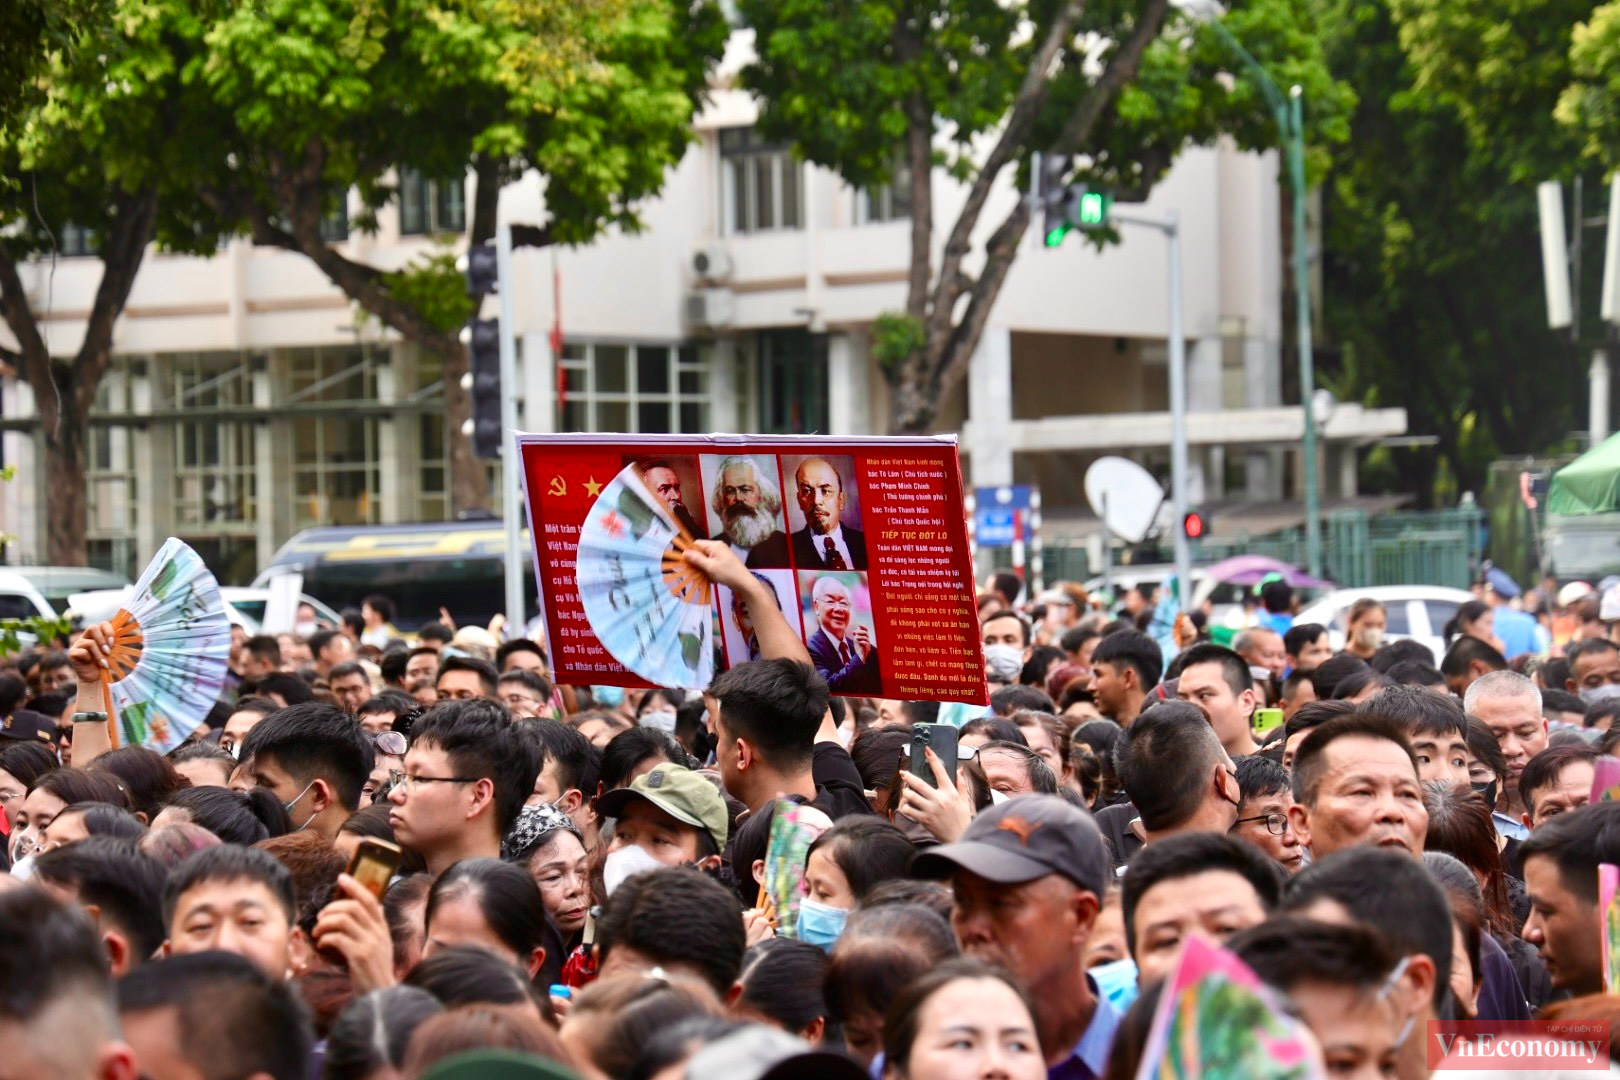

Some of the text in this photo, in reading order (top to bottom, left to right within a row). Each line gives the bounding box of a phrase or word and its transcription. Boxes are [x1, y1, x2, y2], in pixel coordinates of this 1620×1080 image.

[544, 524, 560, 536] Một
[881, 528, 899, 539] TIẾP
[900, 531, 917, 540] TỤC
[547, 541, 562, 552] Việt
[552, 577, 562, 587] cụ
[556, 594, 564, 604] cụ
[562, 644, 576, 654] cho
